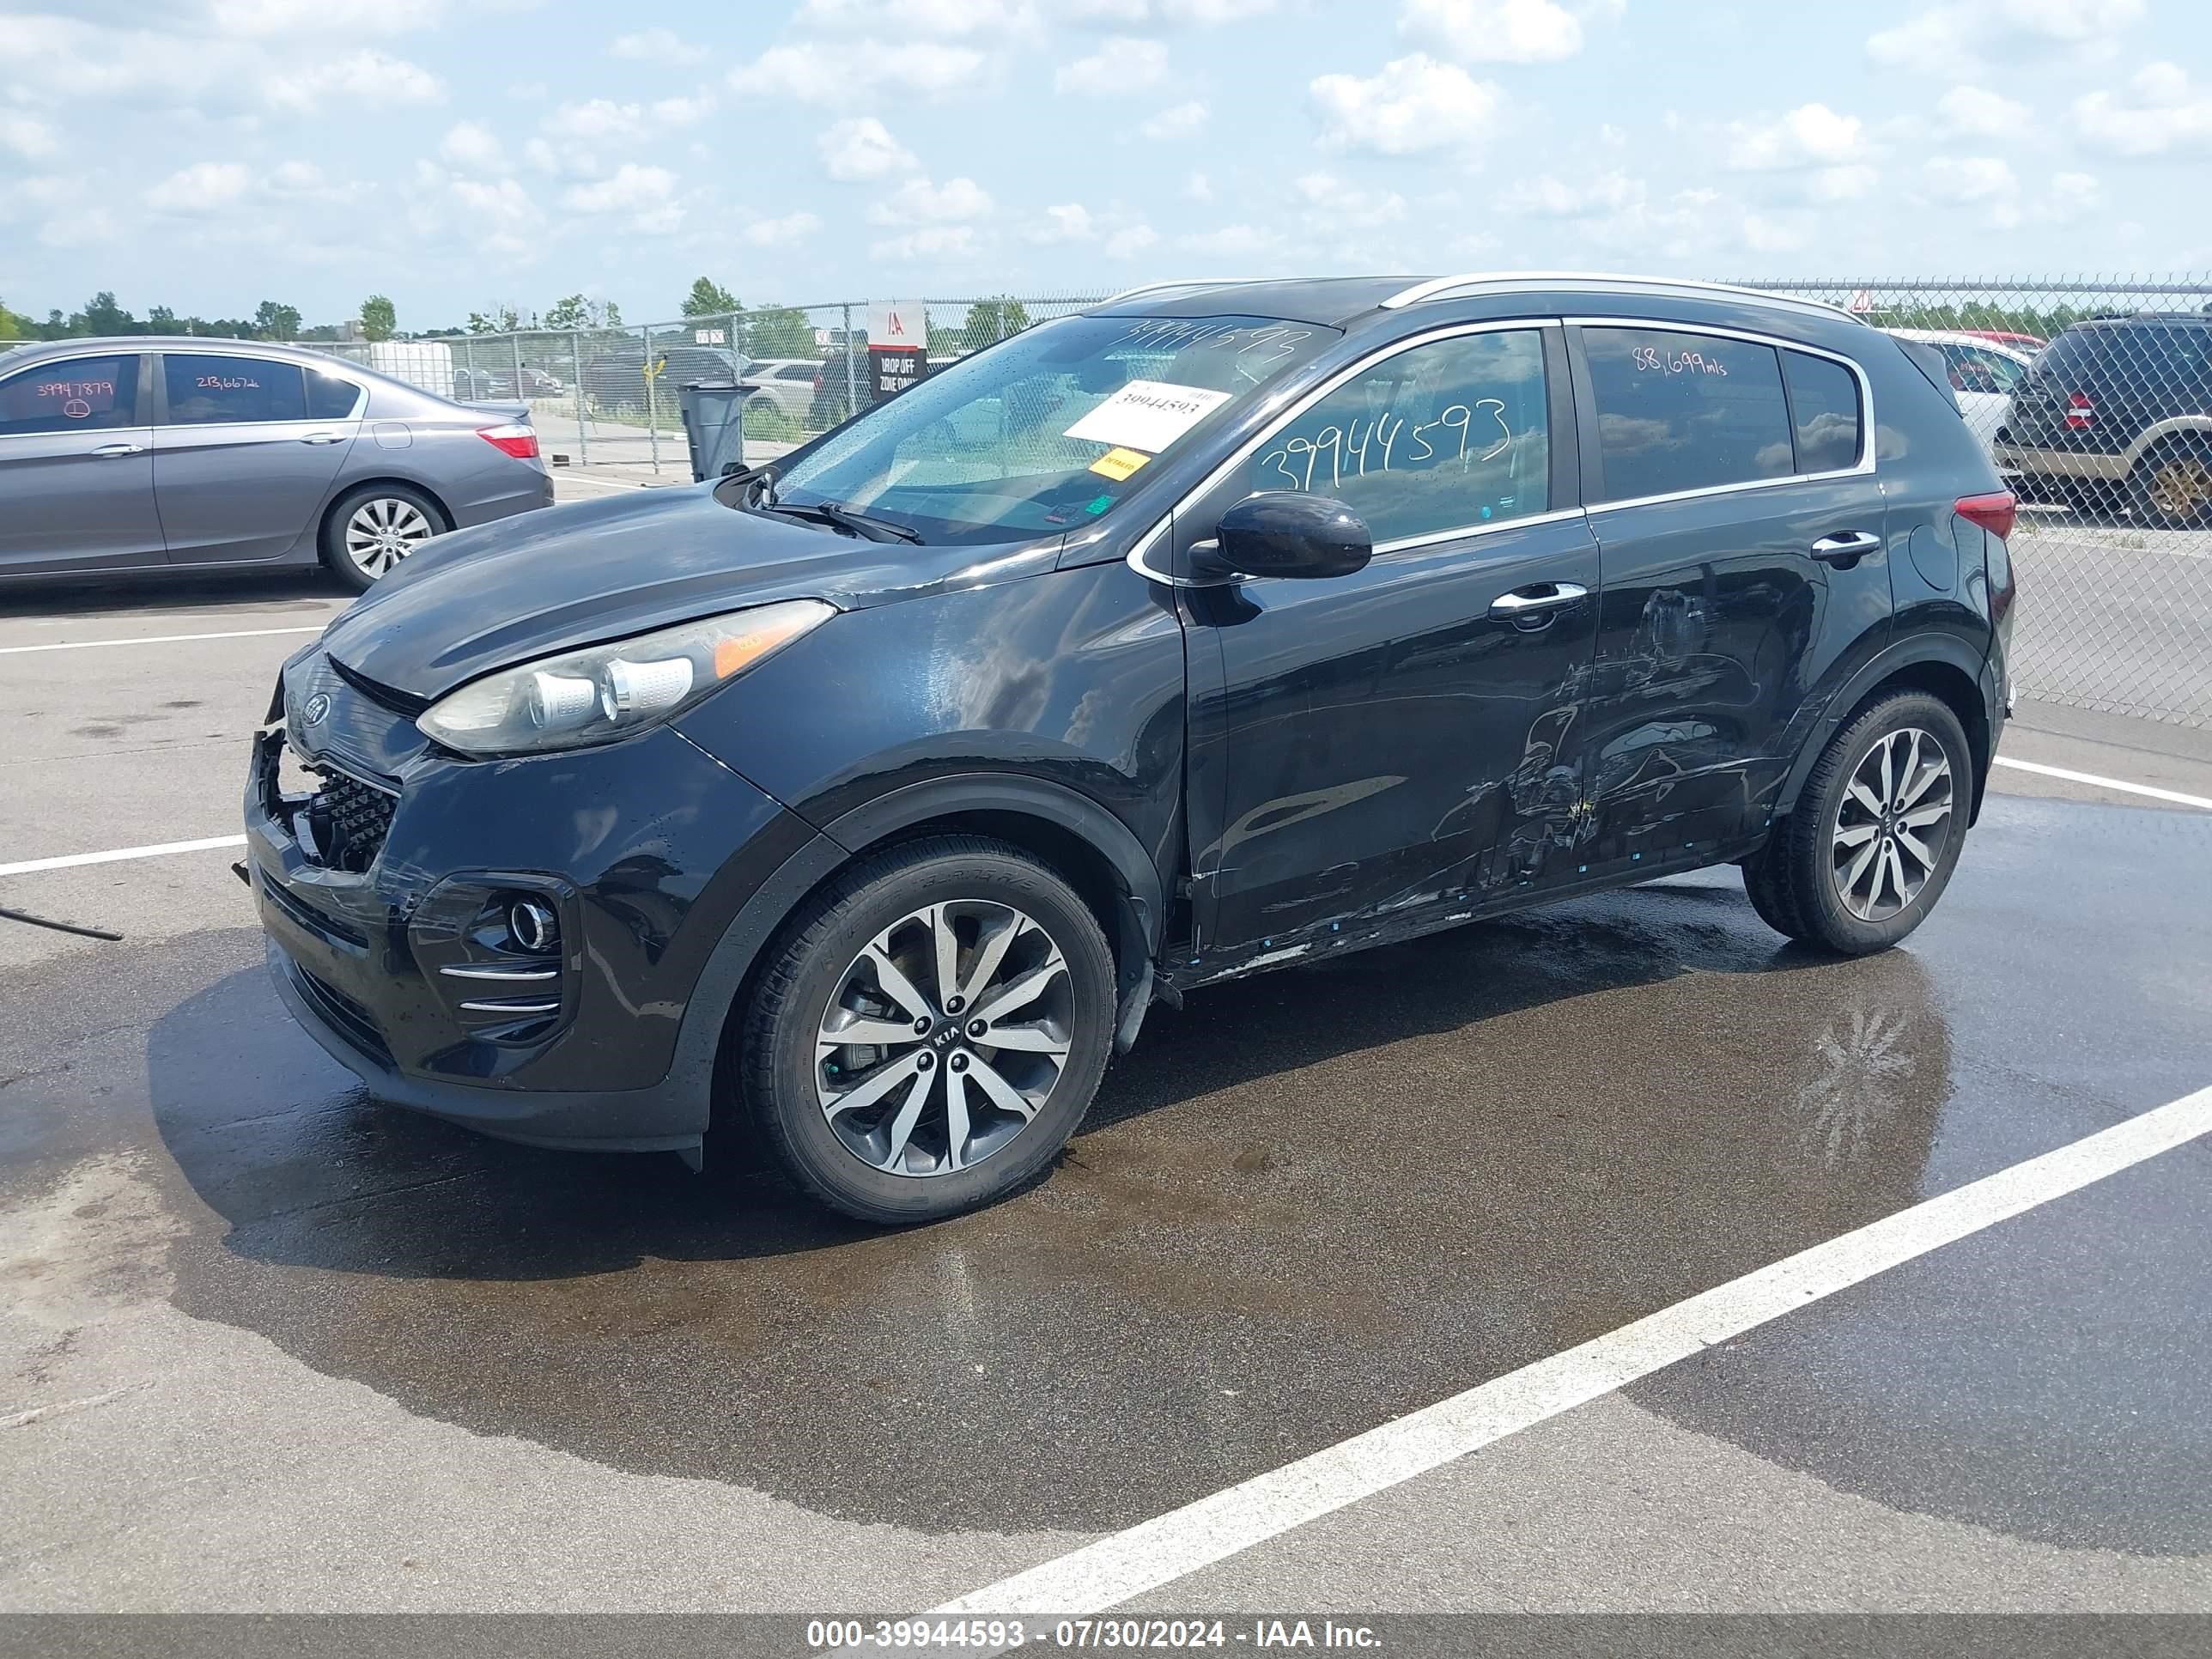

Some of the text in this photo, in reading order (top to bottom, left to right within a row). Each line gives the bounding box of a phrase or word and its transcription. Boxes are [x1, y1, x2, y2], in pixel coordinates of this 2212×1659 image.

[881, 357, 915, 374] DROP OFF
[36, 381, 113, 398] 39947879
[879, 375, 919, 392] ZONE ON
[1115, 392, 1200, 415] 39944593
[1261, 398, 1511, 492] 39944593
[933, 1026, 960, 1048] KIA
